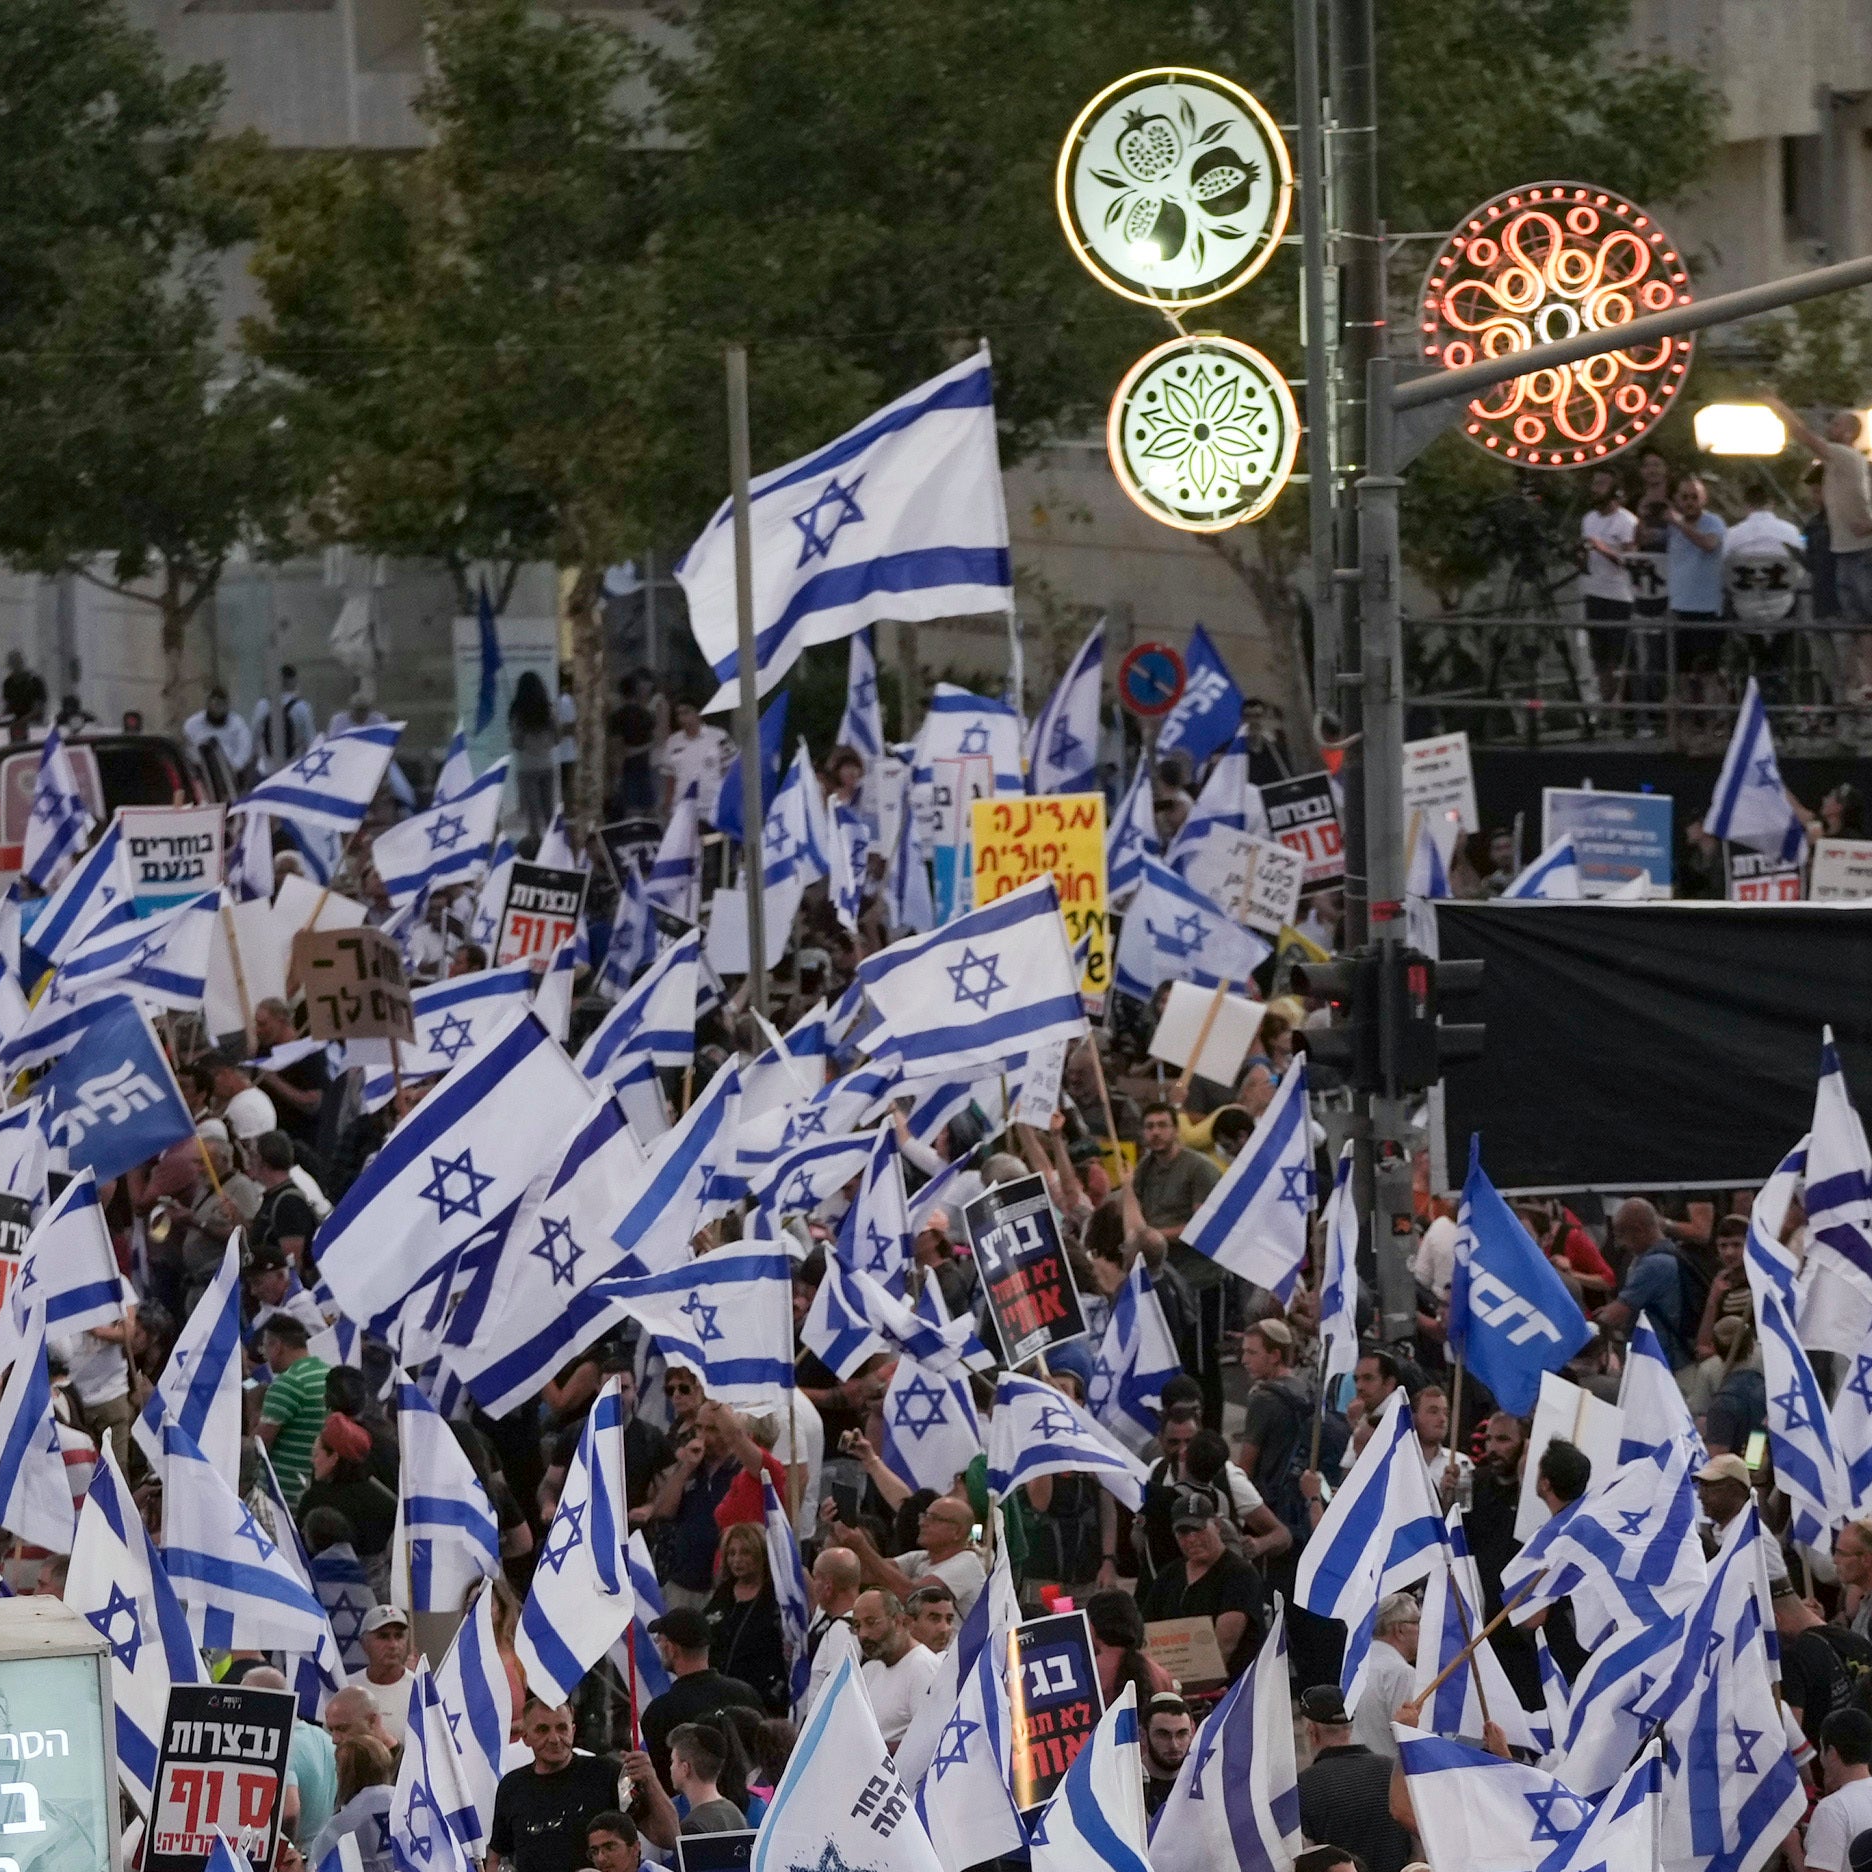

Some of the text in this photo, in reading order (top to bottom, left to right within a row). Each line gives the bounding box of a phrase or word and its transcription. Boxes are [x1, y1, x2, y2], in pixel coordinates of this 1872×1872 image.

[993, 803, 1097, 838] מדינה
[129, 834, 214, 857] בוחרים
[169, 1719, 281, 1761] נבצרות
[169, 1767, 278, 1833] סוף
